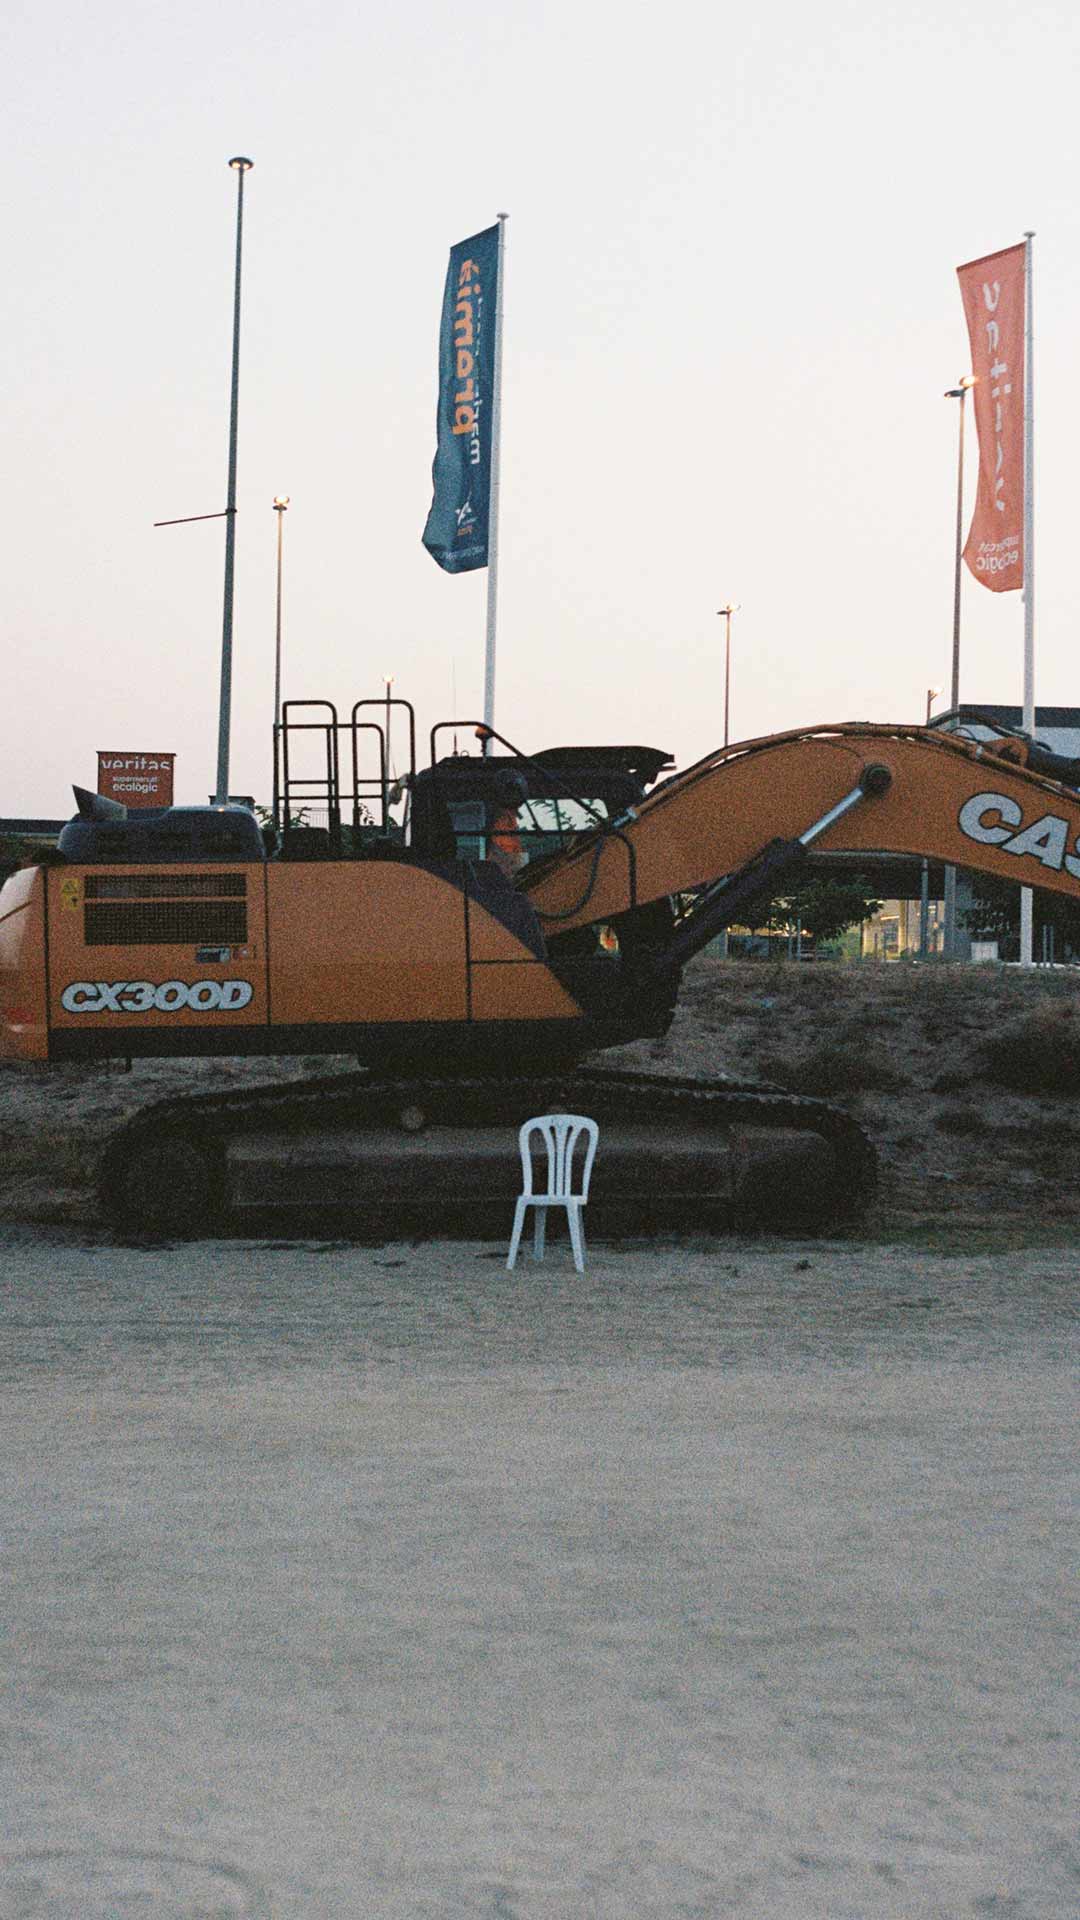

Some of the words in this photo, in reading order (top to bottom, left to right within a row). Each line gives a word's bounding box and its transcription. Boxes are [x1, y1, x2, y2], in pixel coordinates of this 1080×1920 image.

[101, 755, 171, 770] veritas
[957, 791, 1080, 879] CA
[61, 979, 254, 1013] CX300D
